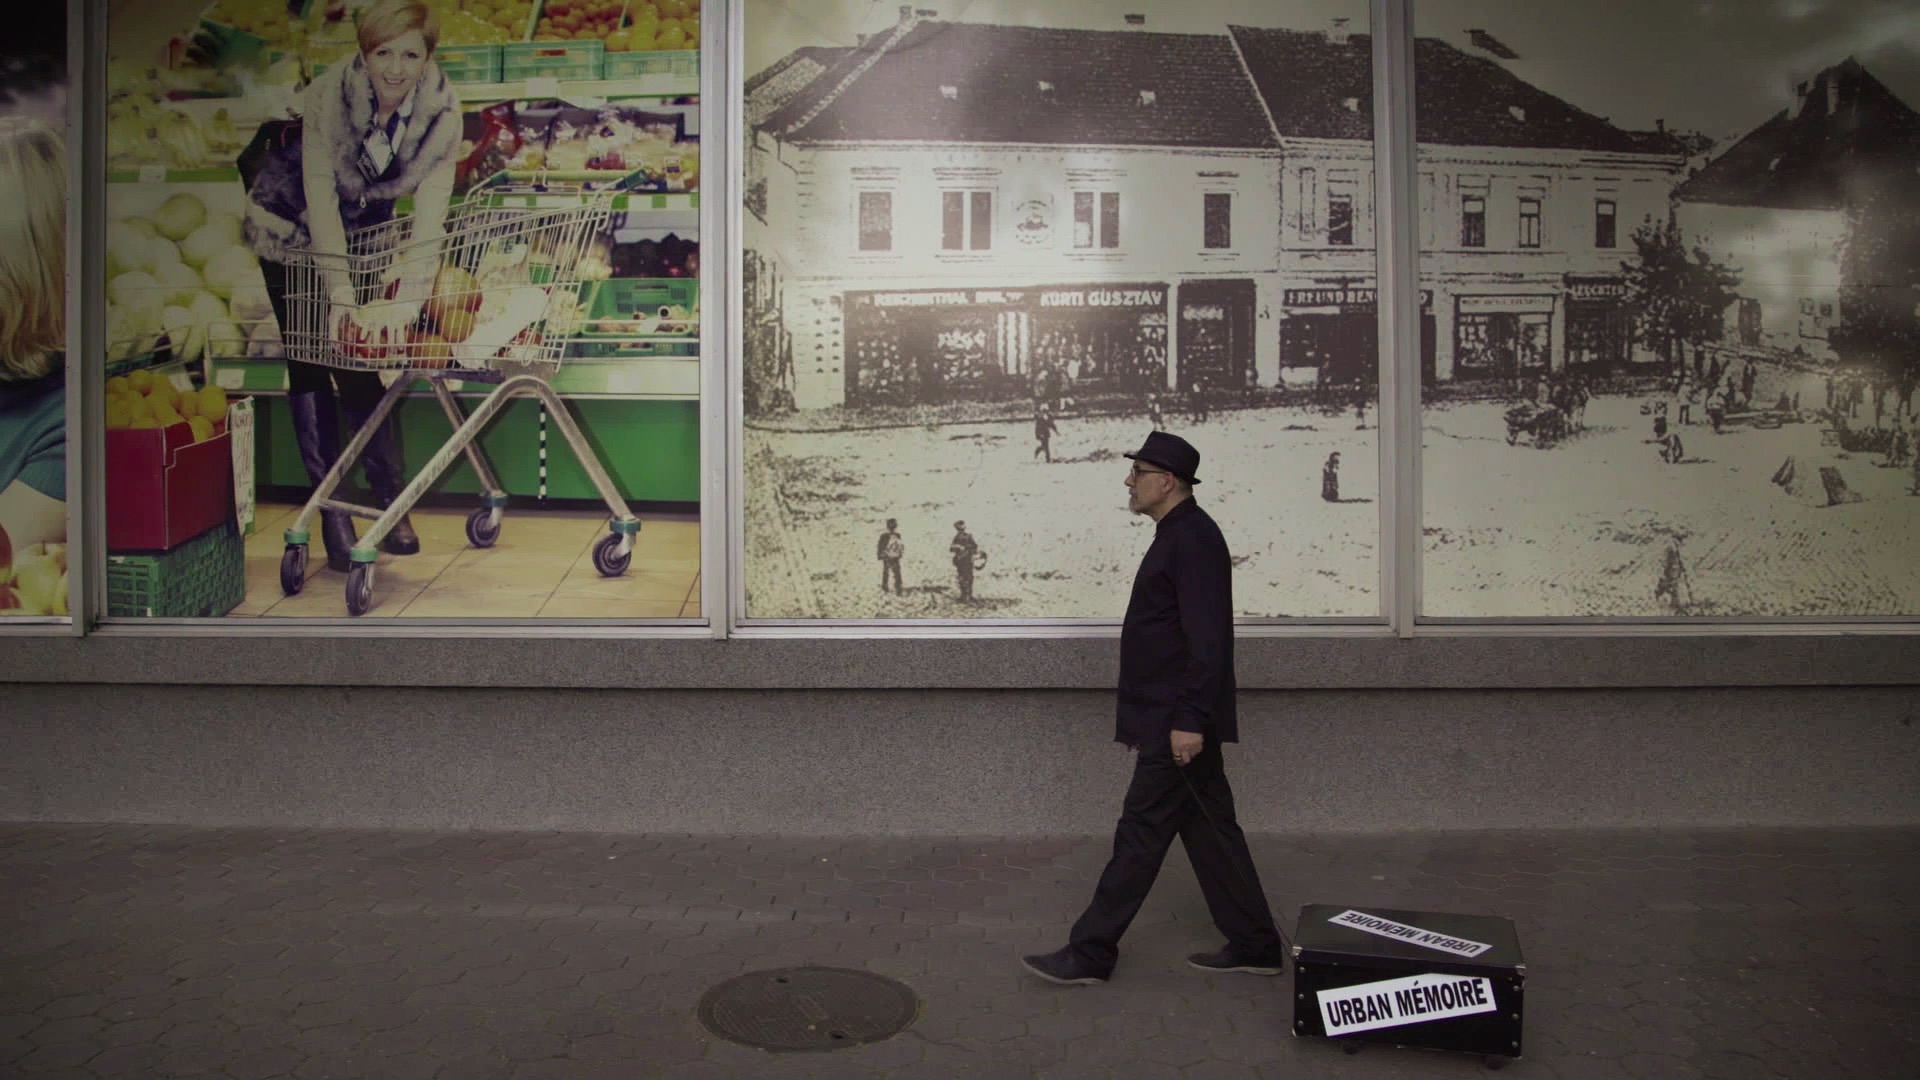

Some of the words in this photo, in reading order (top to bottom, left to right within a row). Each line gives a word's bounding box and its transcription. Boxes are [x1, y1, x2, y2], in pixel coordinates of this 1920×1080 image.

[1417, 933, 1482, 954] URBAN
[1326, 993, 1393, 1027] URBAN
[1395, 977, 1488, 1017] MÉMOIRE
